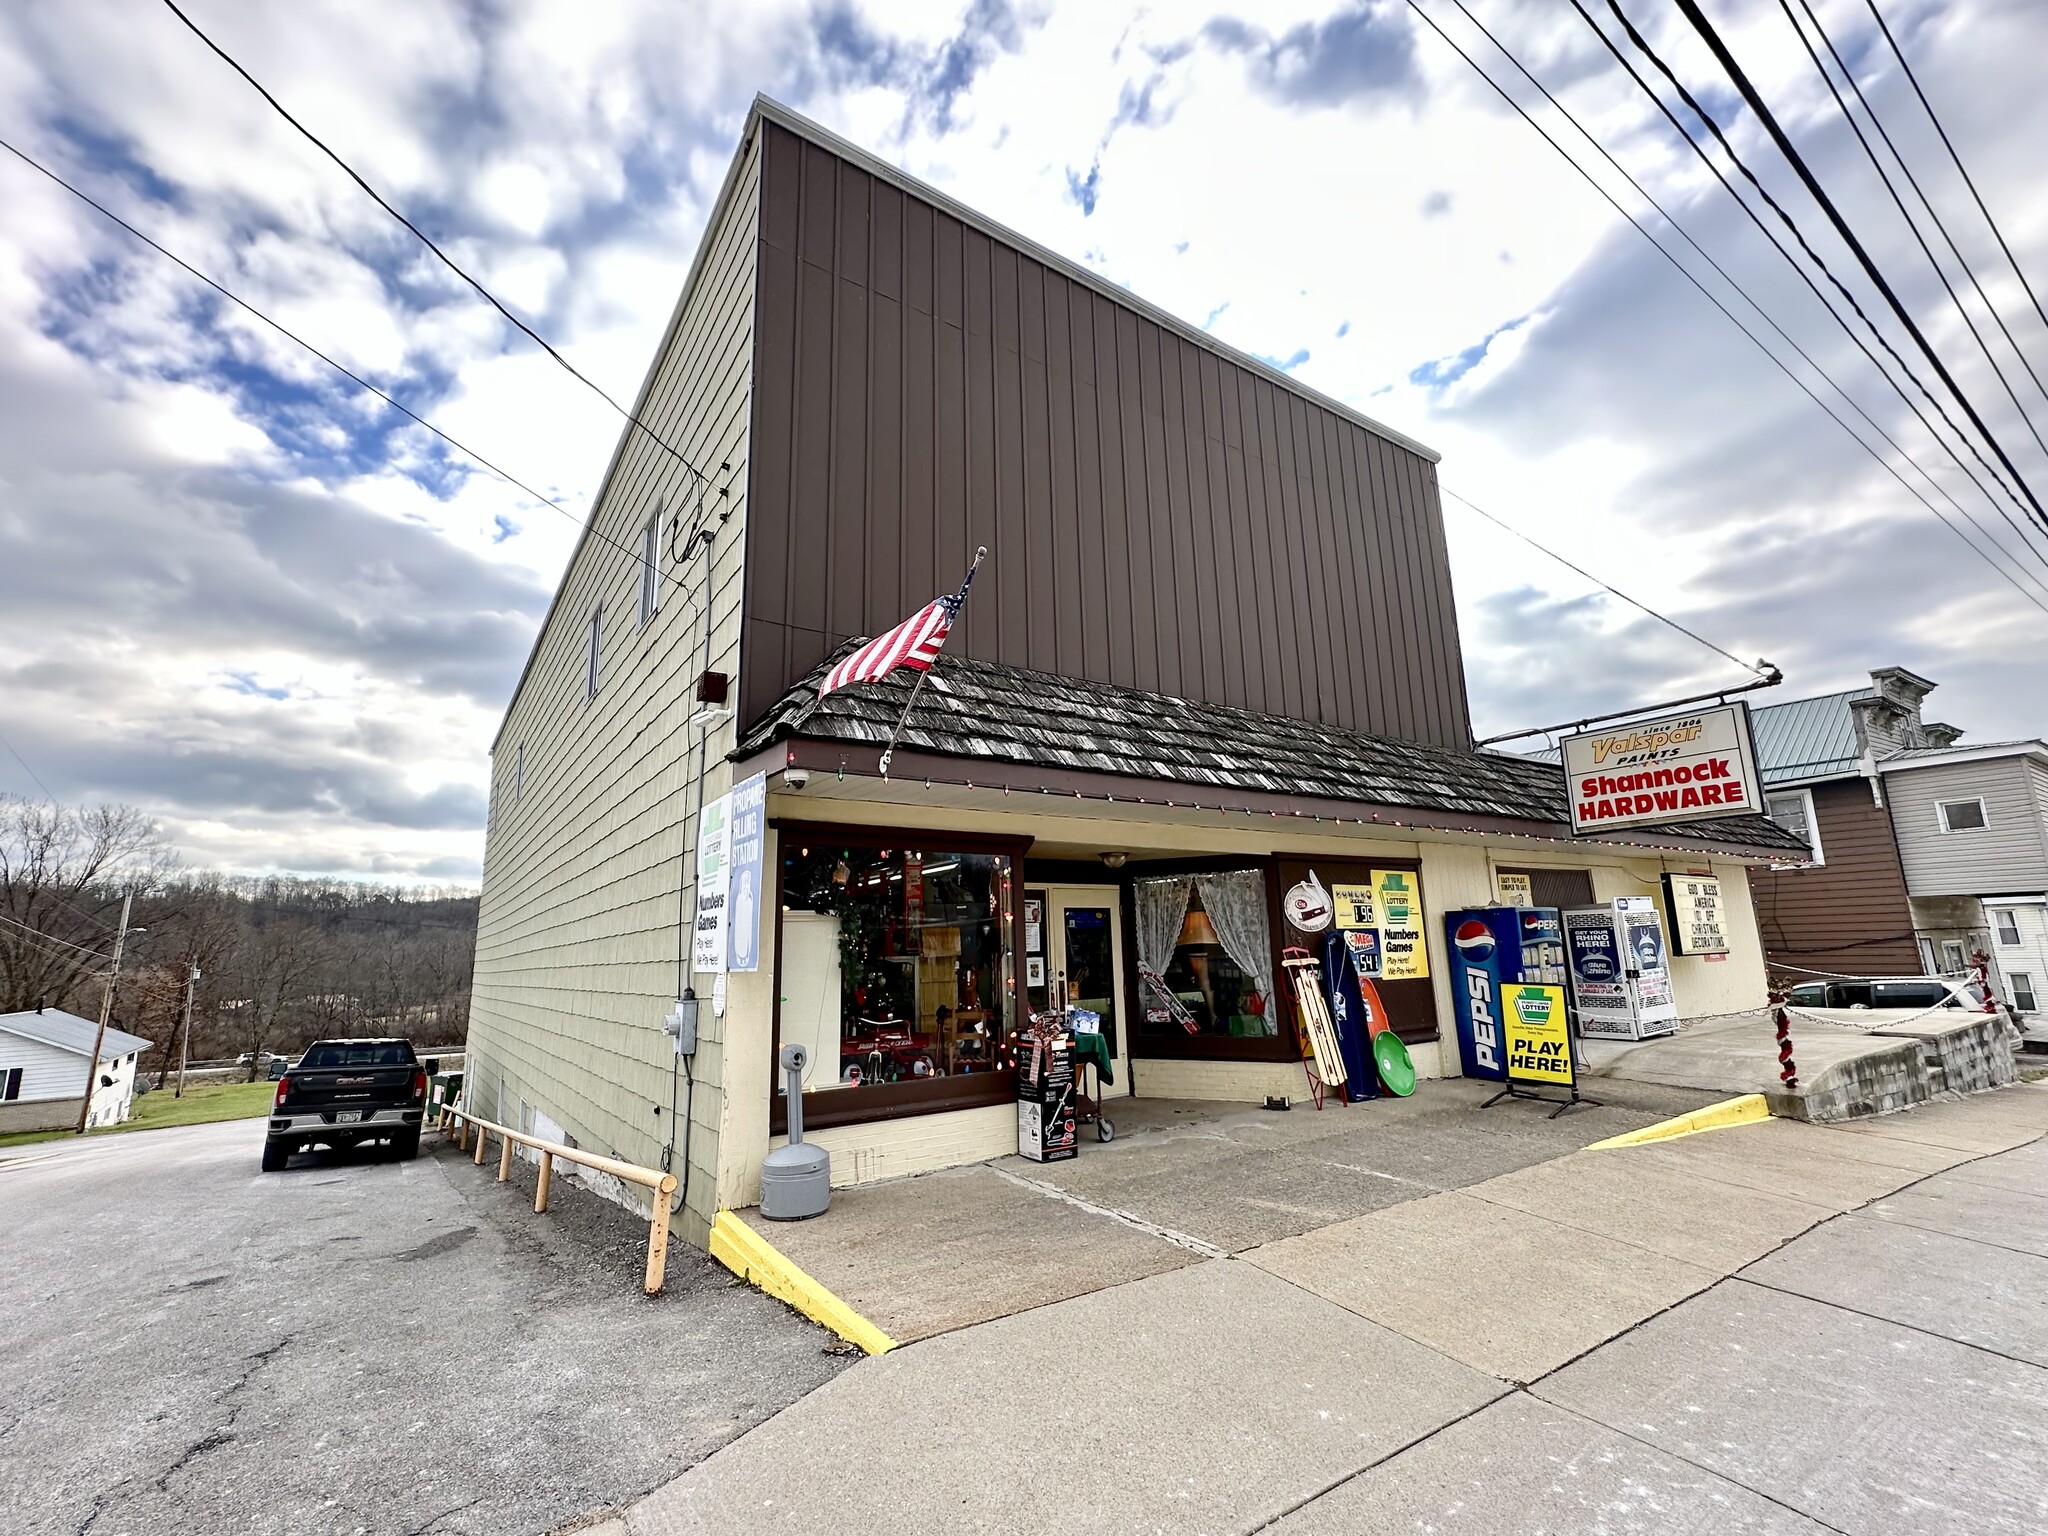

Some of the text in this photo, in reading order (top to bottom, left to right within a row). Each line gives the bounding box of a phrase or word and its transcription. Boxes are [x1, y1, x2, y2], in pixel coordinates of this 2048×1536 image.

[1644, 719, 1701, 734] since 1806
[1592, 724, 1702, 764] Valspar
[1616, 748, 1680, 765] PAINTS
[1582, 758, 1730, 797] Shannock
[734, 782, 763, 816] PROPANE
[1578, 781, 1743, 821] HARDWARE
[732, 838, 759, 867] STATION
[1688, 884, 1717, 895] GOD BLESS
[699, 892, 724, 911] Numbers
[1695, 897, 1715, 908] AMERICA
[1355, 906, 1372, 921] 196
[1706, 911, 1714, 921] OFF
[698, 914, 717, 931] Games
[1692, 924, 1719, 934] CHRISTMAS
[1384, 929, 1419, 939] Numbers
[1386, 942, 1413, 952] Games
[1692, 937, 1724, 948] DECORATIONS
[1360, 955, 1378, 971] 541
[1466, 967, 1500, 1071] PEPSI
[1514, 1039, 1564, 1056] PLAY
[1511, 1055, 1568, 1073] HERE!
[336, 1077, 374, 1085] GMC
